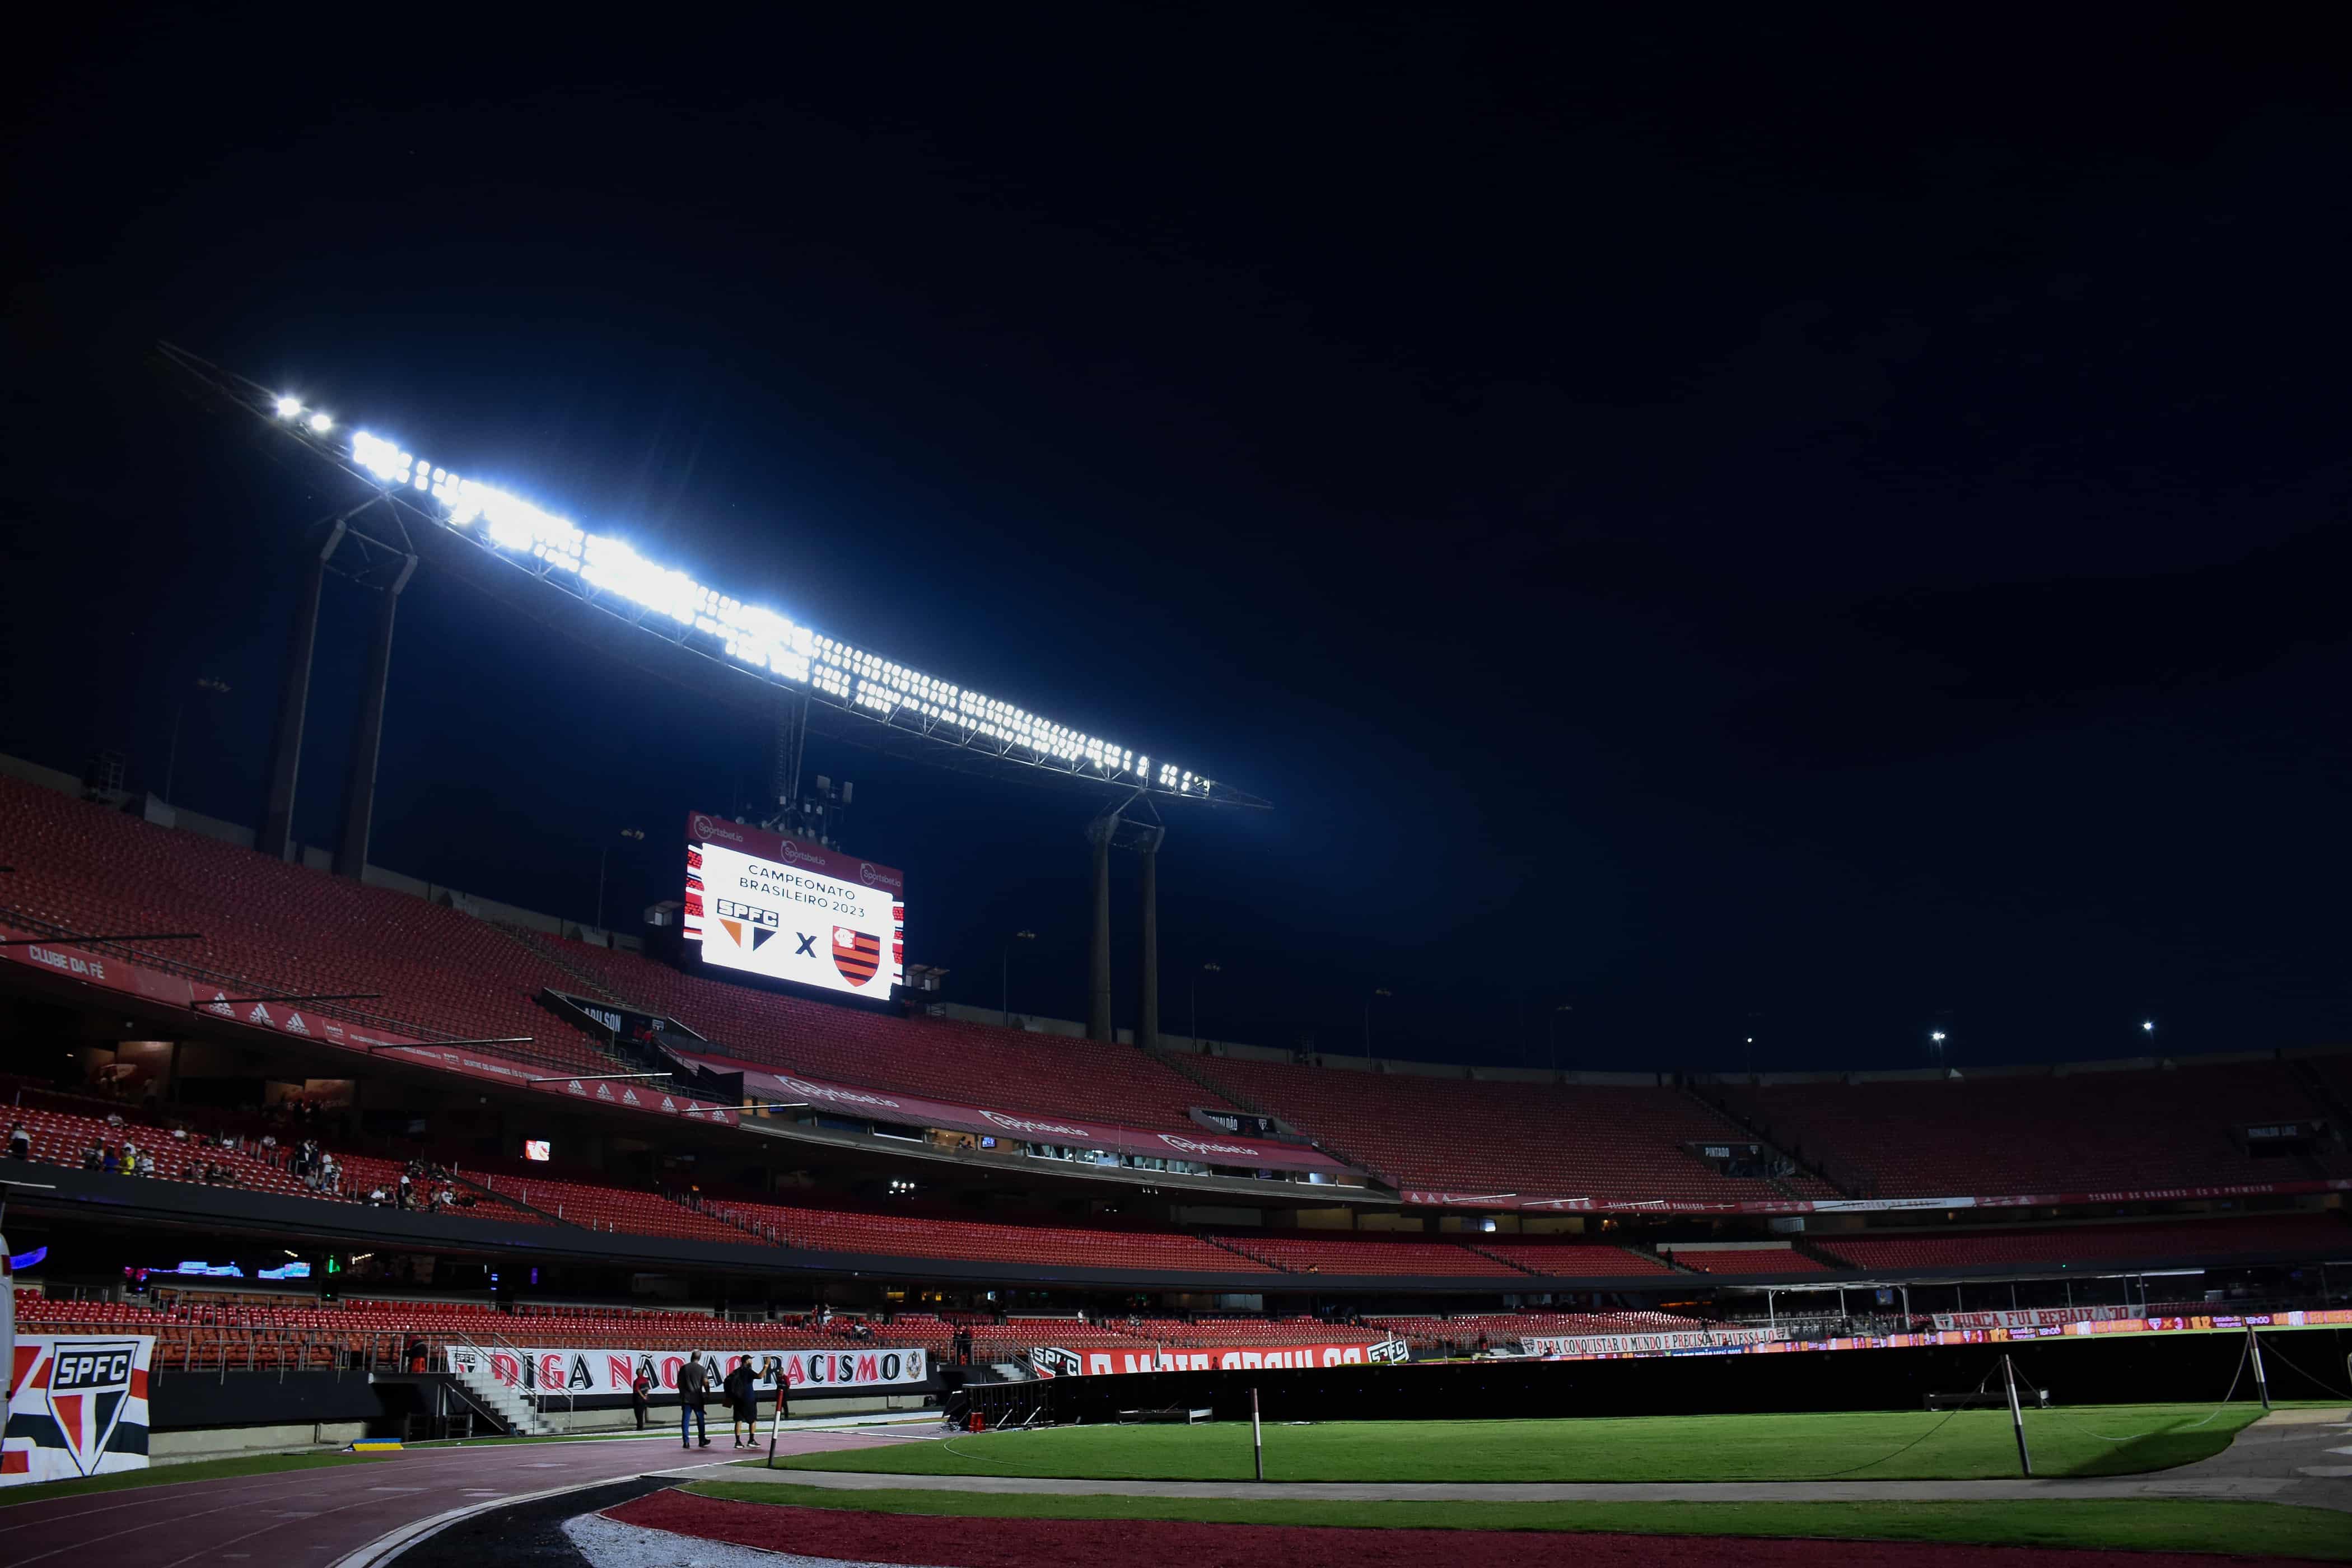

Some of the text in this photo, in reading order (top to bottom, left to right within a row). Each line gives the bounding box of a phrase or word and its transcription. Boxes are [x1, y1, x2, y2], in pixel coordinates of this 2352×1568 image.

[740, 878, 865, 917] BRASILEIRO 2023
[749, 865, 855, 900] CAMPEONATO
[718, 900, 778, 927] SPFC
[29, 945, 105, 979] CLUBE DA FÉ
[1951, 1306, 2129, 1329] NUNCA FUI REBAIXADO
[1564, 1338, 1619, 1353] CONQUISTAR
[1622, 1337, 1627, 1351] O
[1631, 1335, 1661, 1350] MUNDO
[58, 1355, 128, 1384] SPFC
[489, 1352, 594, 1390] DIGA
[760, 1352, 901, 1387] RACISMO
